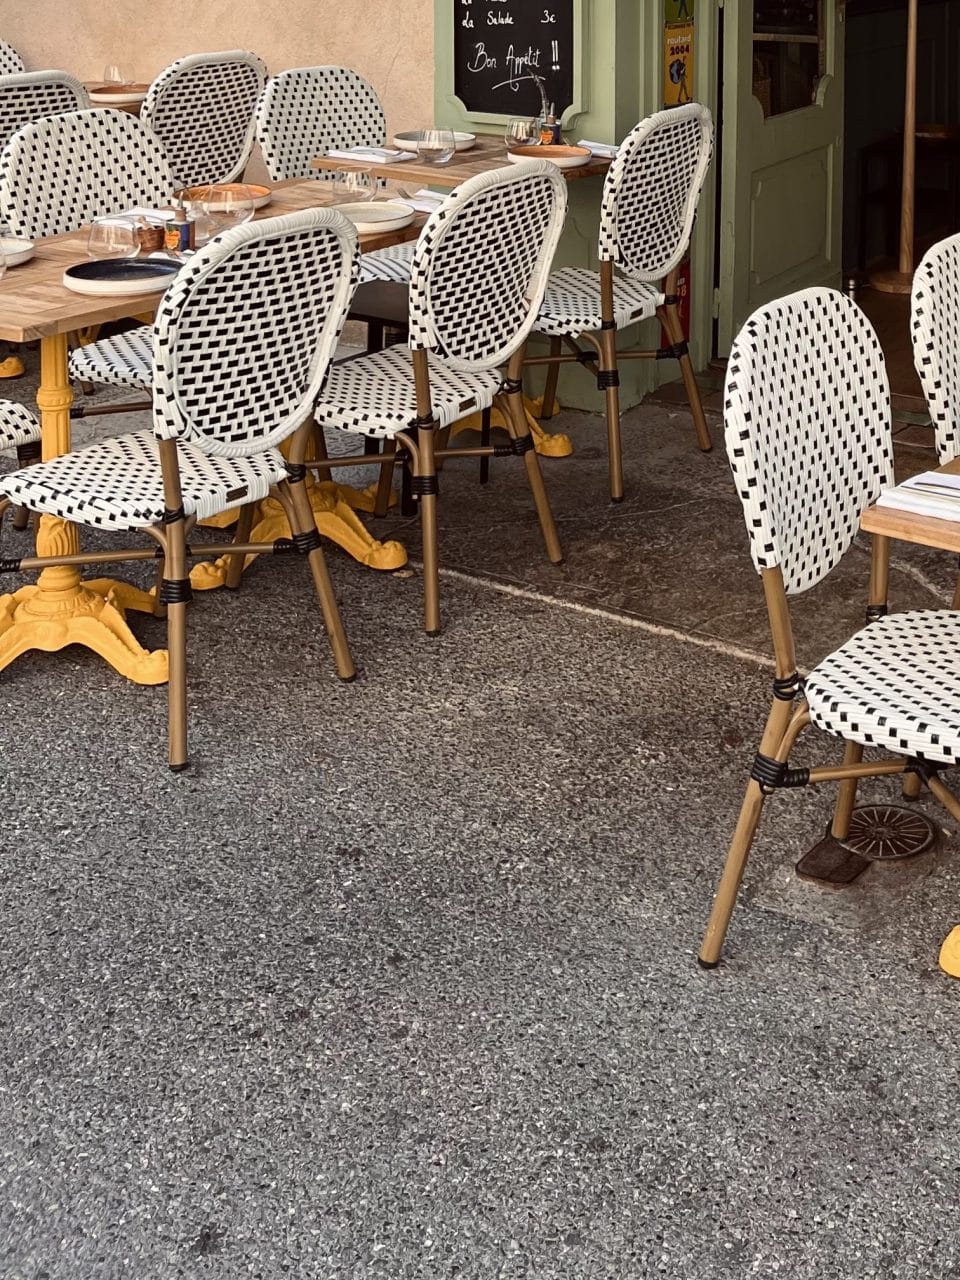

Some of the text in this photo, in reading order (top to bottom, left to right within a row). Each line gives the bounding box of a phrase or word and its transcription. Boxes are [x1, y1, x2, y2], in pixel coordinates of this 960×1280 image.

[462, 9, 556, 28] La Salade 3€
[467, 42, 497, 73] Bon
[670, 44, 690, 56] 2004
